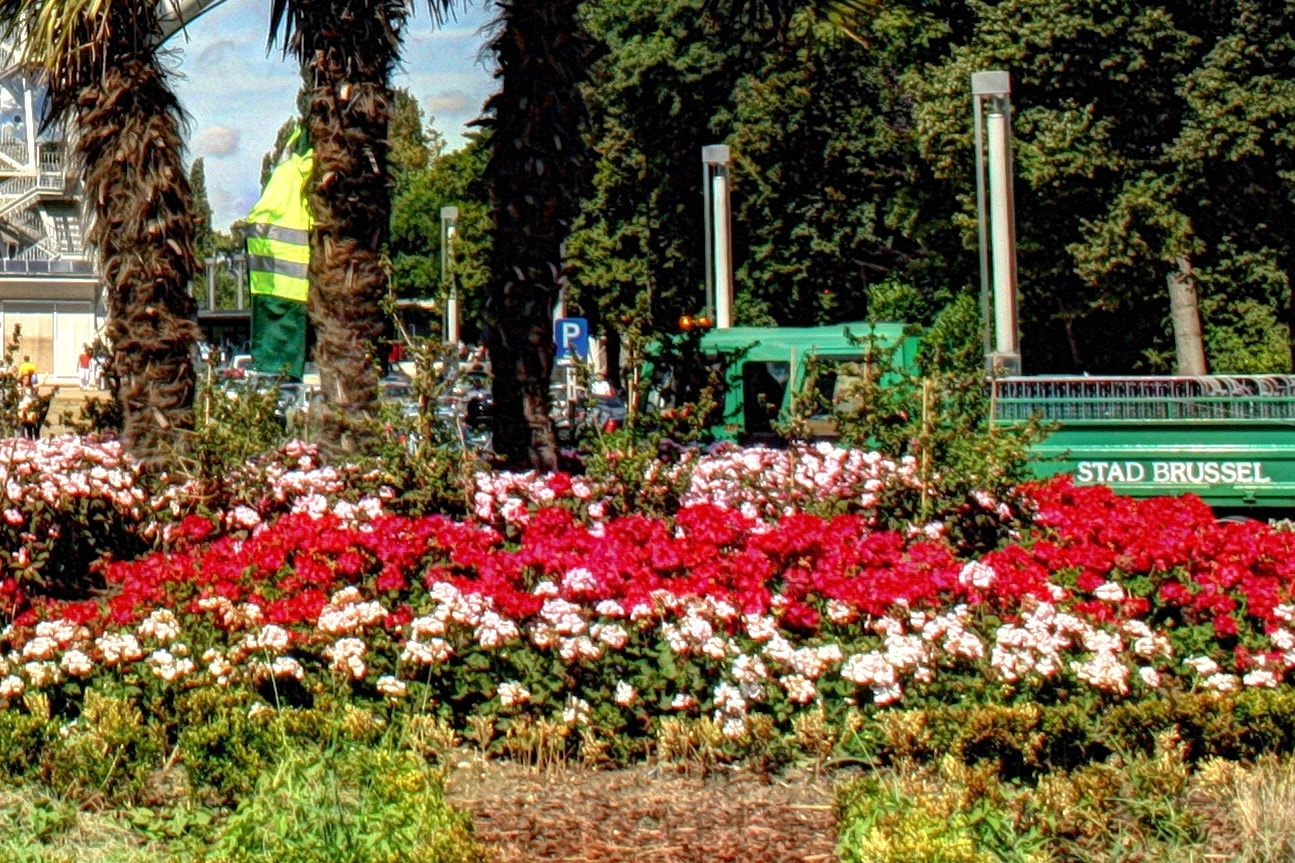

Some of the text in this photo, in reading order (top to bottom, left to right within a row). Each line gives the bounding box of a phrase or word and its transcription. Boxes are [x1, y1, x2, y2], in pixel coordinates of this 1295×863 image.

[563, 322, 580, 348] P
[1077, 461, 1270, 483] STAD BRUSSEL
